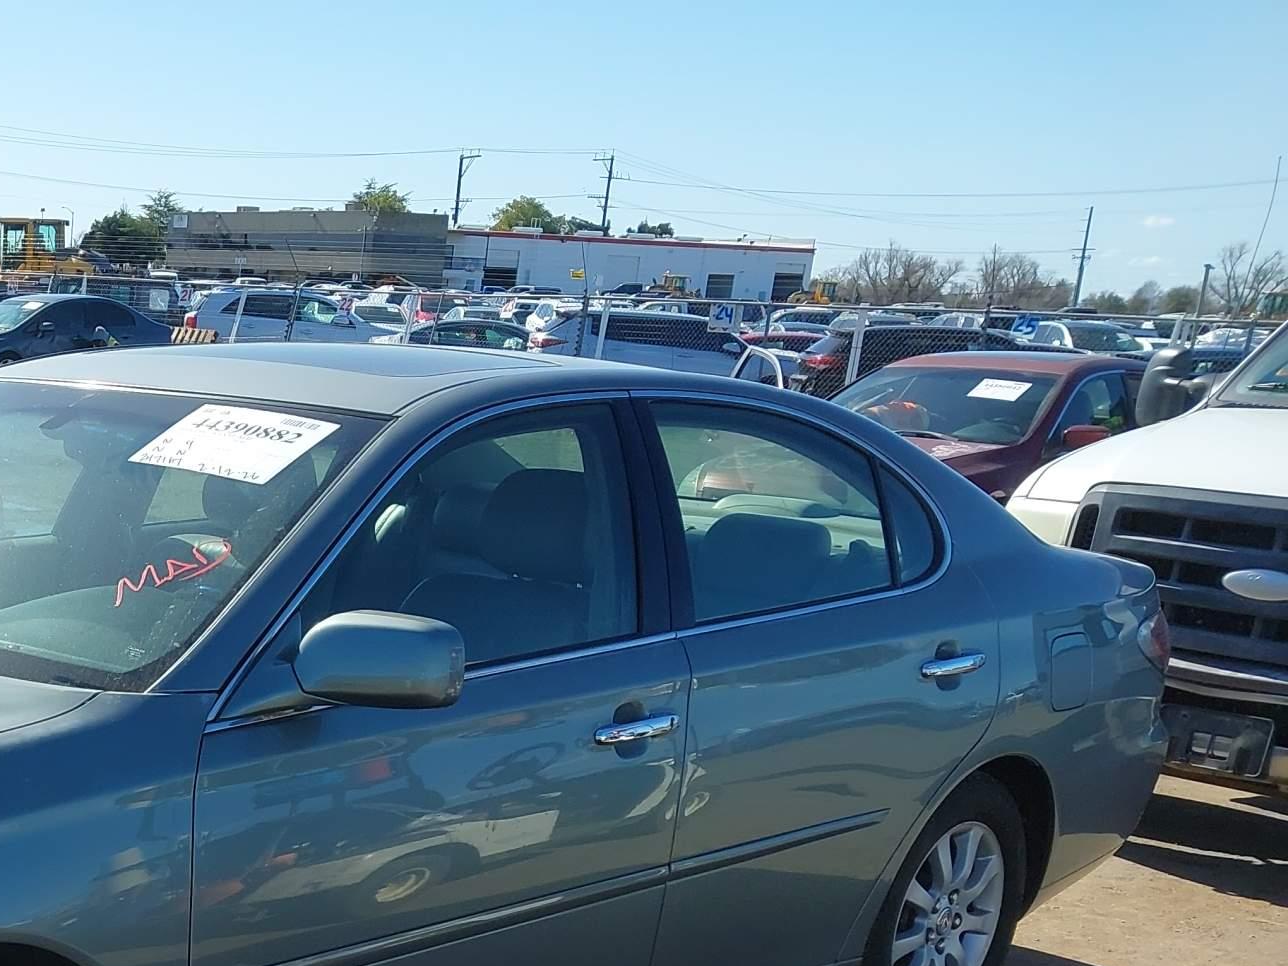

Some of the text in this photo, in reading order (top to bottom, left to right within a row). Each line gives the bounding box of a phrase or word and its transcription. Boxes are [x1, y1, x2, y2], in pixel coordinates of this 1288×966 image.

[715, 304, 734, 324] 24
[1013, 315, 1041, 335] 25
[192, 418, 303, 444] 44390882
